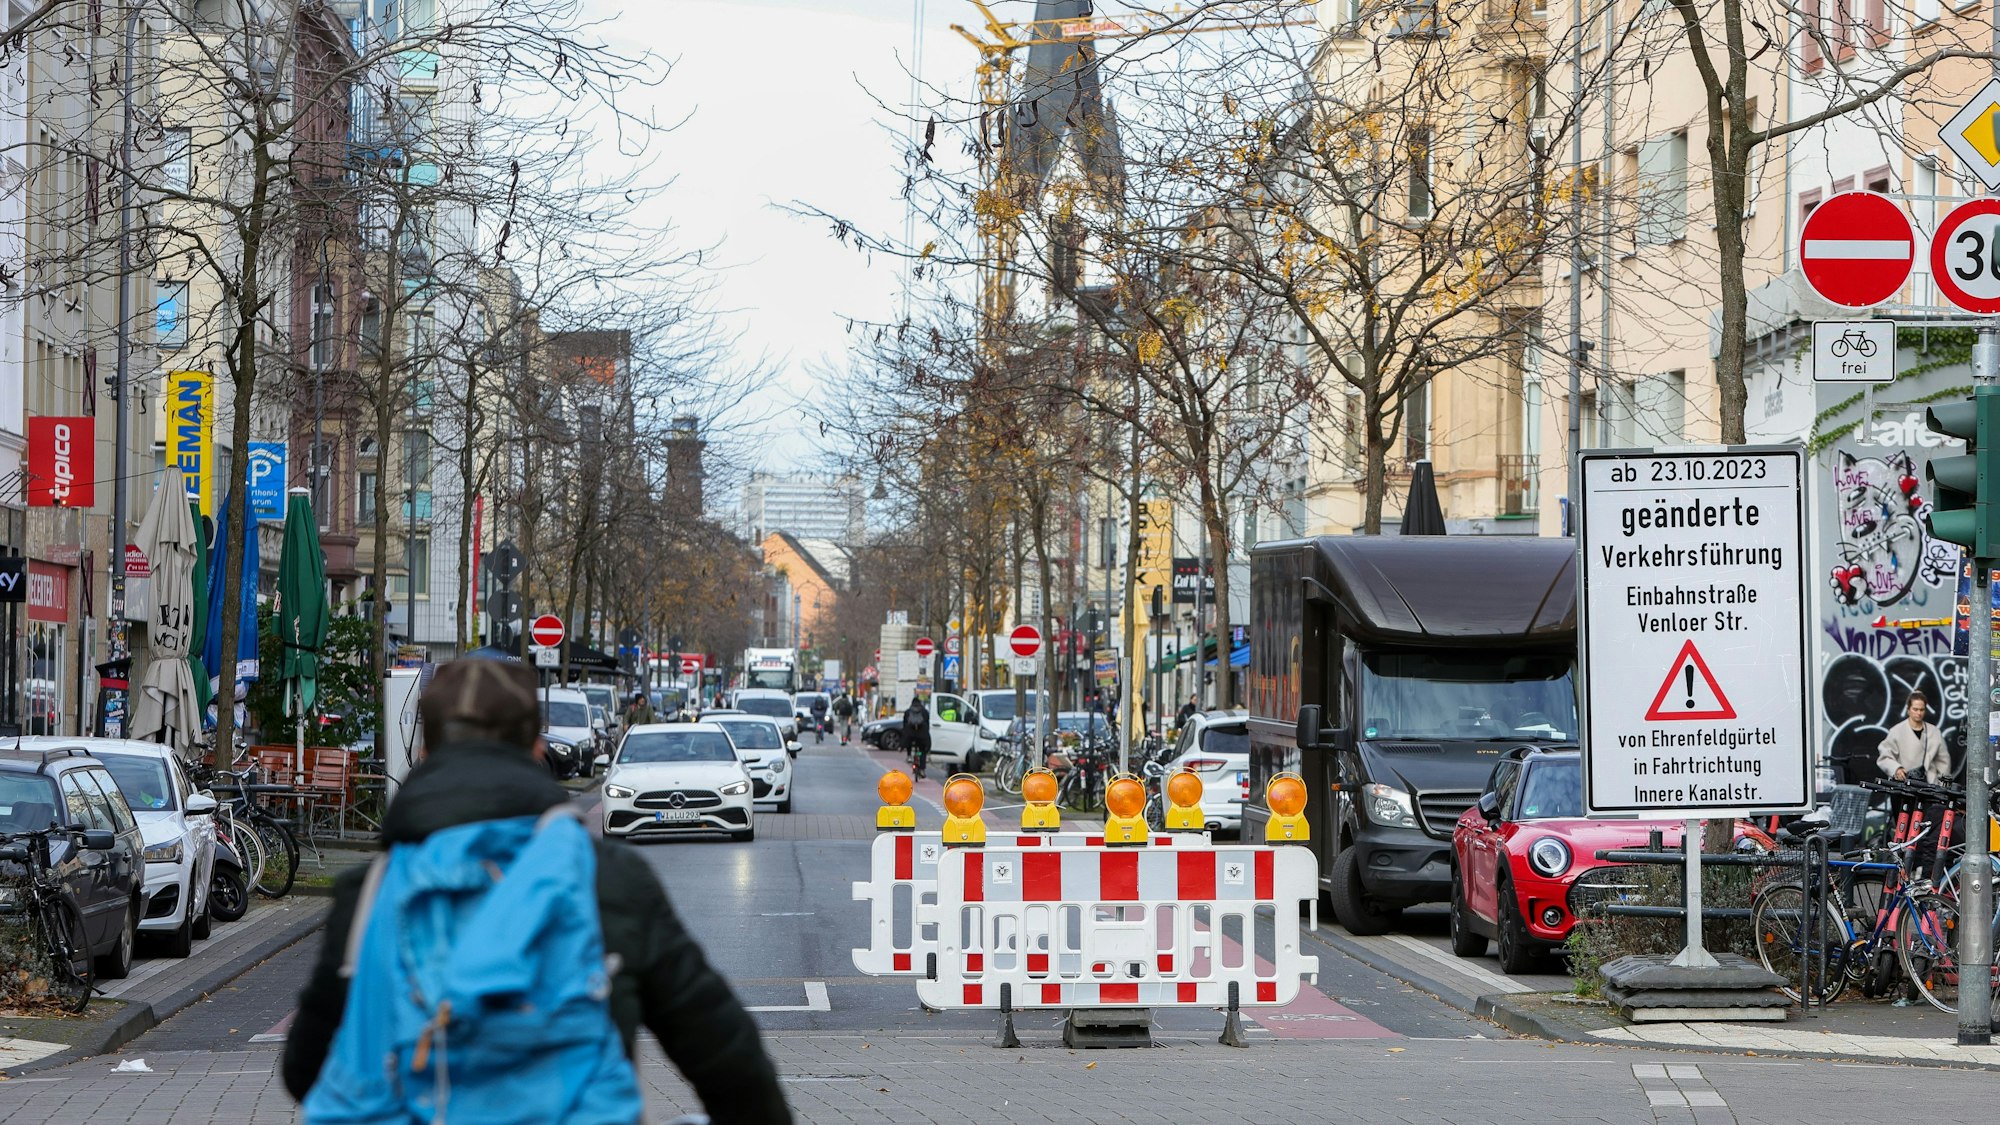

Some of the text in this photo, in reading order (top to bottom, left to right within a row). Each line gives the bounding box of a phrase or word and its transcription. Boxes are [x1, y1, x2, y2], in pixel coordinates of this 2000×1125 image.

[1954, 230, 2000, 281] 3
[1842, 362, 1867, 374] frei
[178, 380, 202, 495] EEMAN
[49, 424, 74, 500] tipico
[1611, 459, 1766, 482] ab 23.10.2023
[251, 489, 278, 497] rthonia
[1622, 497, 1759, 537] geänderte
[1602, 542, 1782, 570] Verkehrsführung
[1627, 584, 1757, 606] Einbahnstraße
[1638, 611, 1748, 633] Venloer Str.
[1619, 727, 1776, 749] von Ehrenfeldgürtel
[1634, 756, 1761, 777] in Fahrtrichtung
[1635, 783, 1762, 802] Innere Kanalstr.
